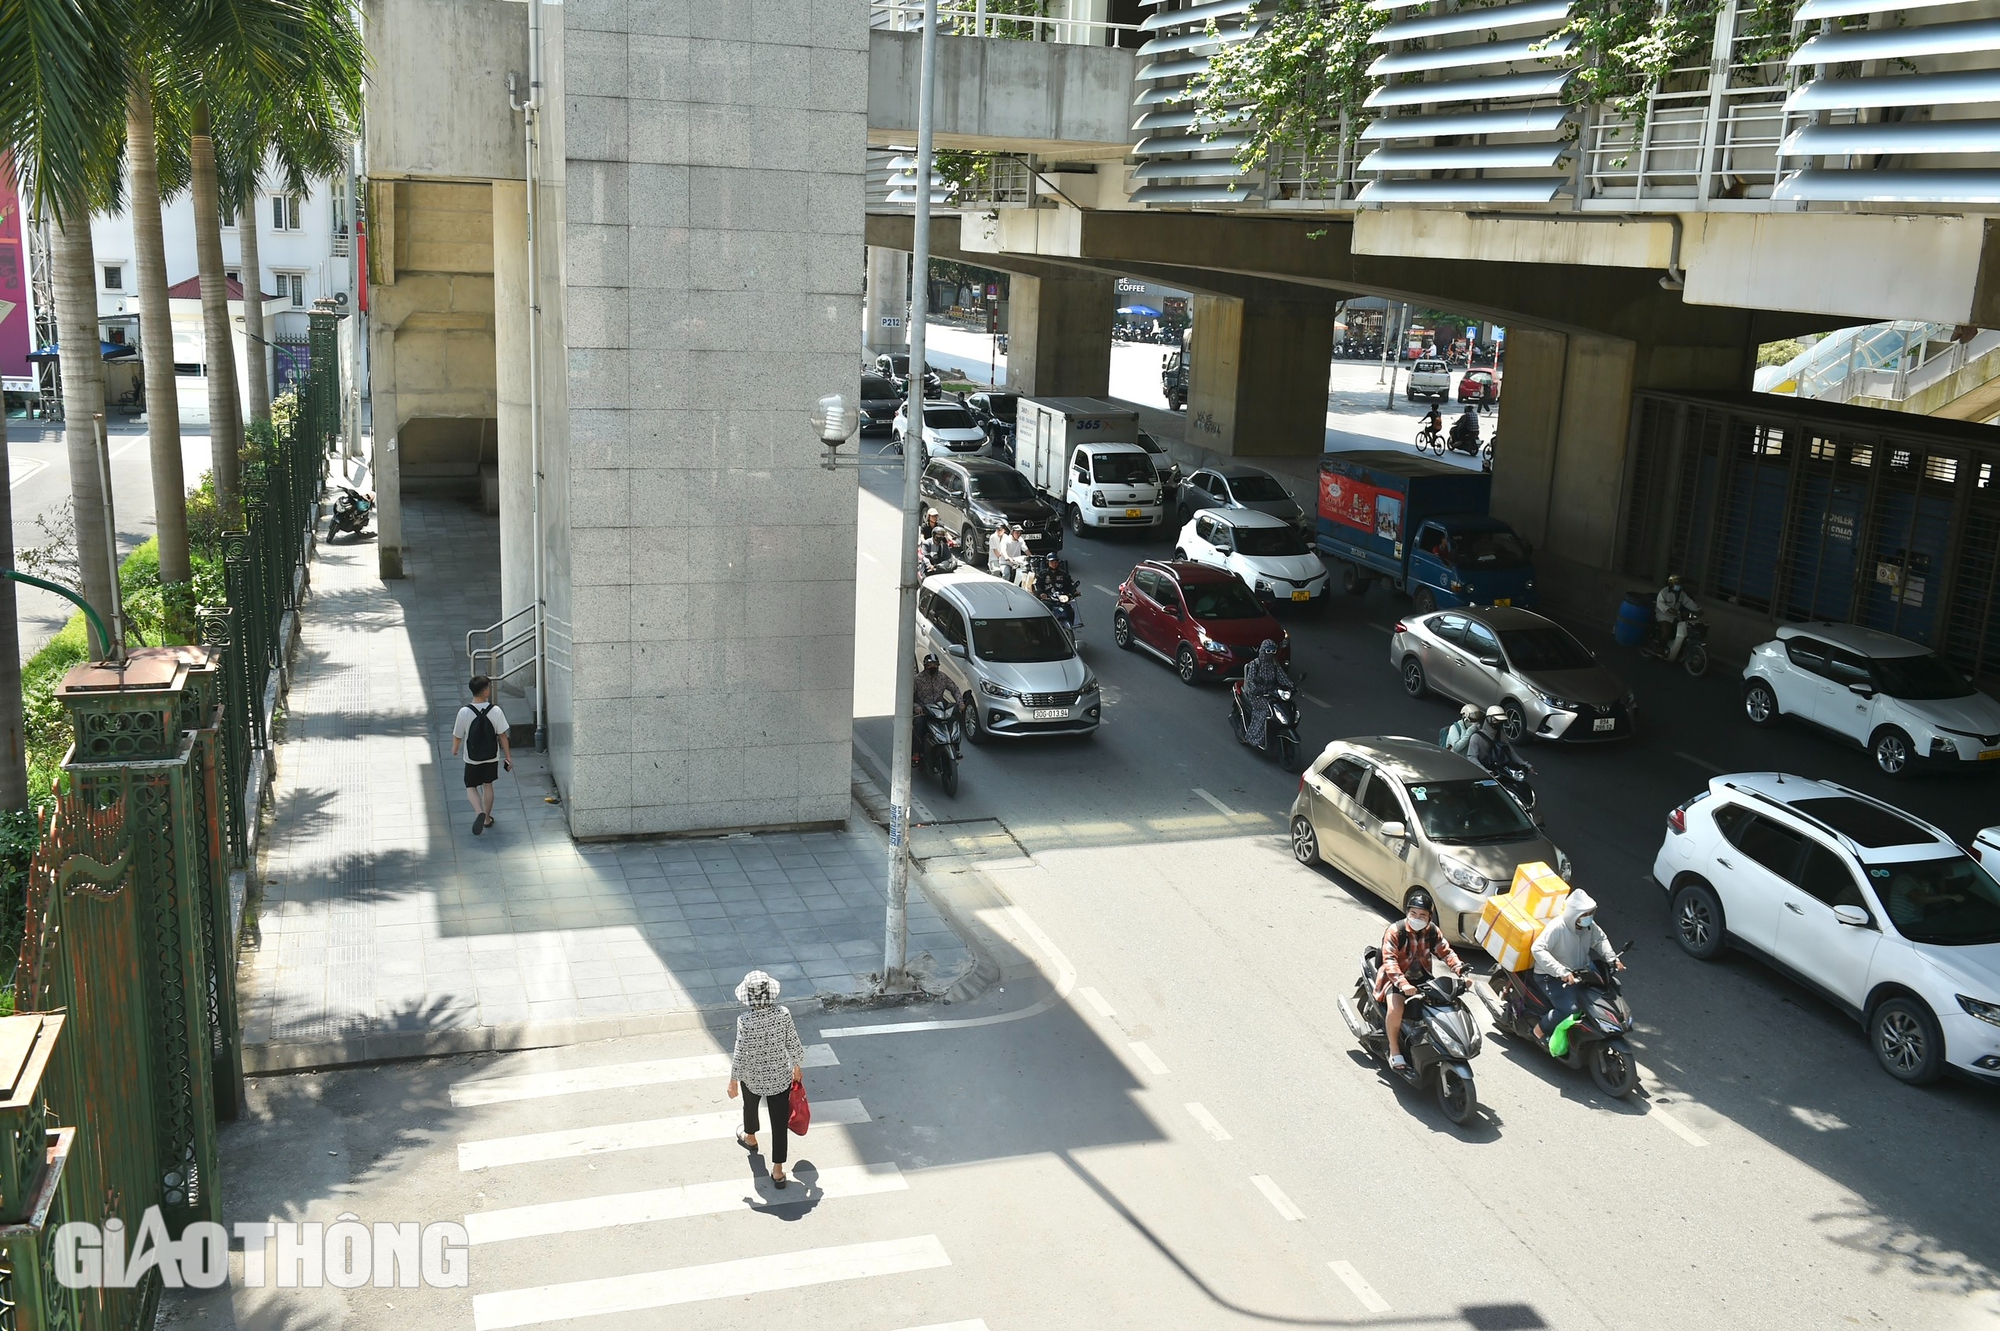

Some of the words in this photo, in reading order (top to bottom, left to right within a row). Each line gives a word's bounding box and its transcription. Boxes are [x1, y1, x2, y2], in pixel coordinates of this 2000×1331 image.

[1118, 283, 1145, 293] COFFEE
[882, 318, 900, 327] P212
[1076, 420, 1101, 430] 365
